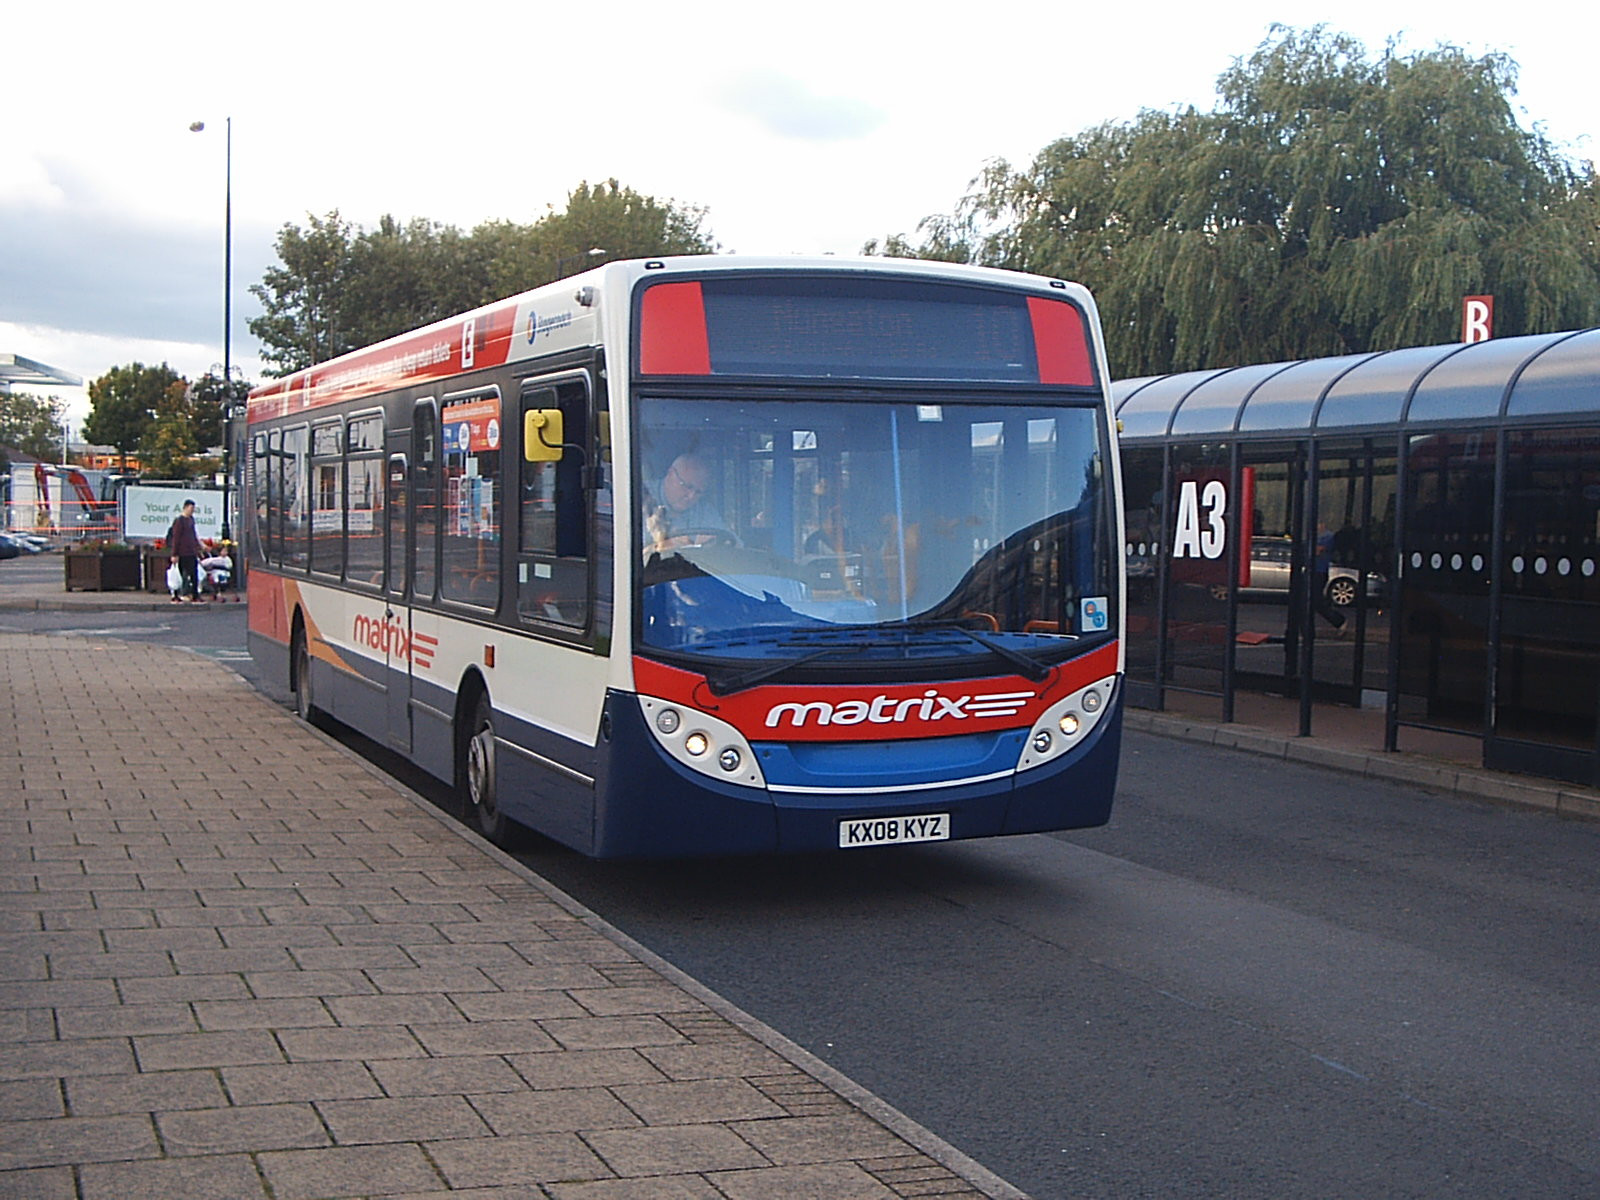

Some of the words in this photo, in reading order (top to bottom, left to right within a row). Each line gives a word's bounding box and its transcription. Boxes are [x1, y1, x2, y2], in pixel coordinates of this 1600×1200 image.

[1465, 299, 1489, 344] B
[141, 514, 170, 524] open
[195, 516, 216, 526] sual
[145, 502, 170, 512] Your
[173, 503, 201, 514] Aa
[204, 504, 213, 514] is
[1172, 480, 1226, 560] A3
[354, 614, 412, 662] matrix
[765, 690, 970, 727] matrix
[848, 819, 899, 844] KX08
[903, 816, 942, 839] KYZ
